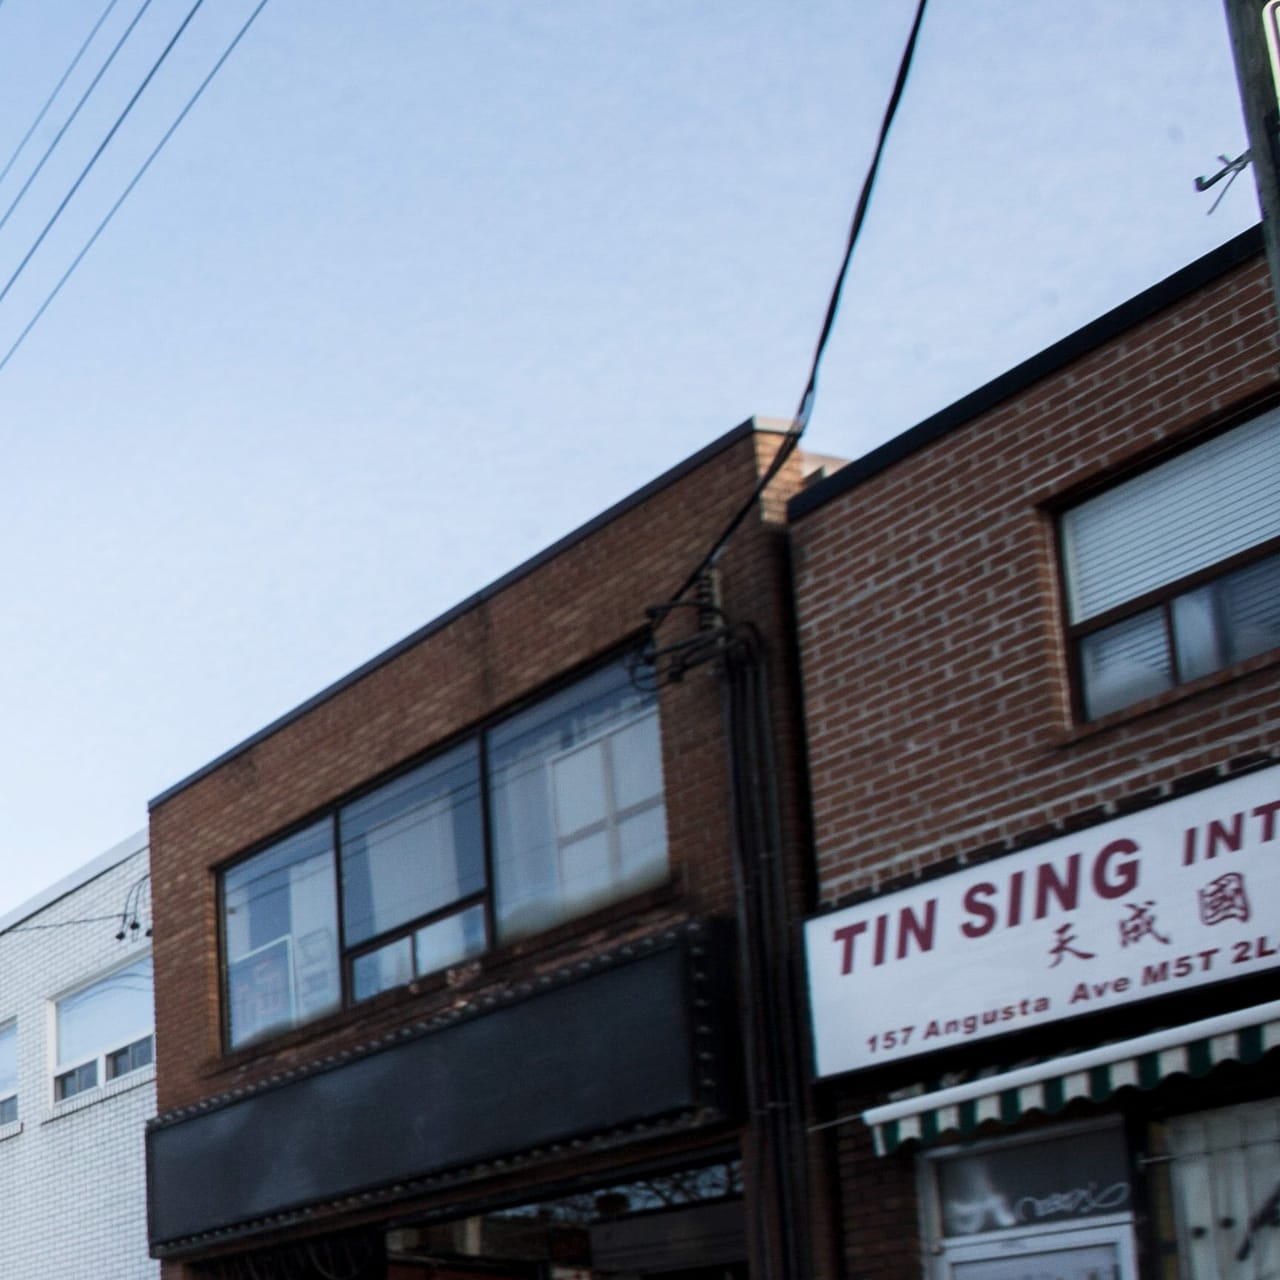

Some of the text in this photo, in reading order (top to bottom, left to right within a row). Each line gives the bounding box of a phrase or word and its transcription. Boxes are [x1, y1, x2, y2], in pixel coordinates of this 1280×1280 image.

[833, 898, 937, 976] TIN
[961, 837, 1140, 938] SING
[866, 1025, 916, 1053] 157
[923, 997, 1050, 1040] Angusta
[1070, 977, 1131, 1004] Ave
[1142, 948, 1220, 987] M5T
